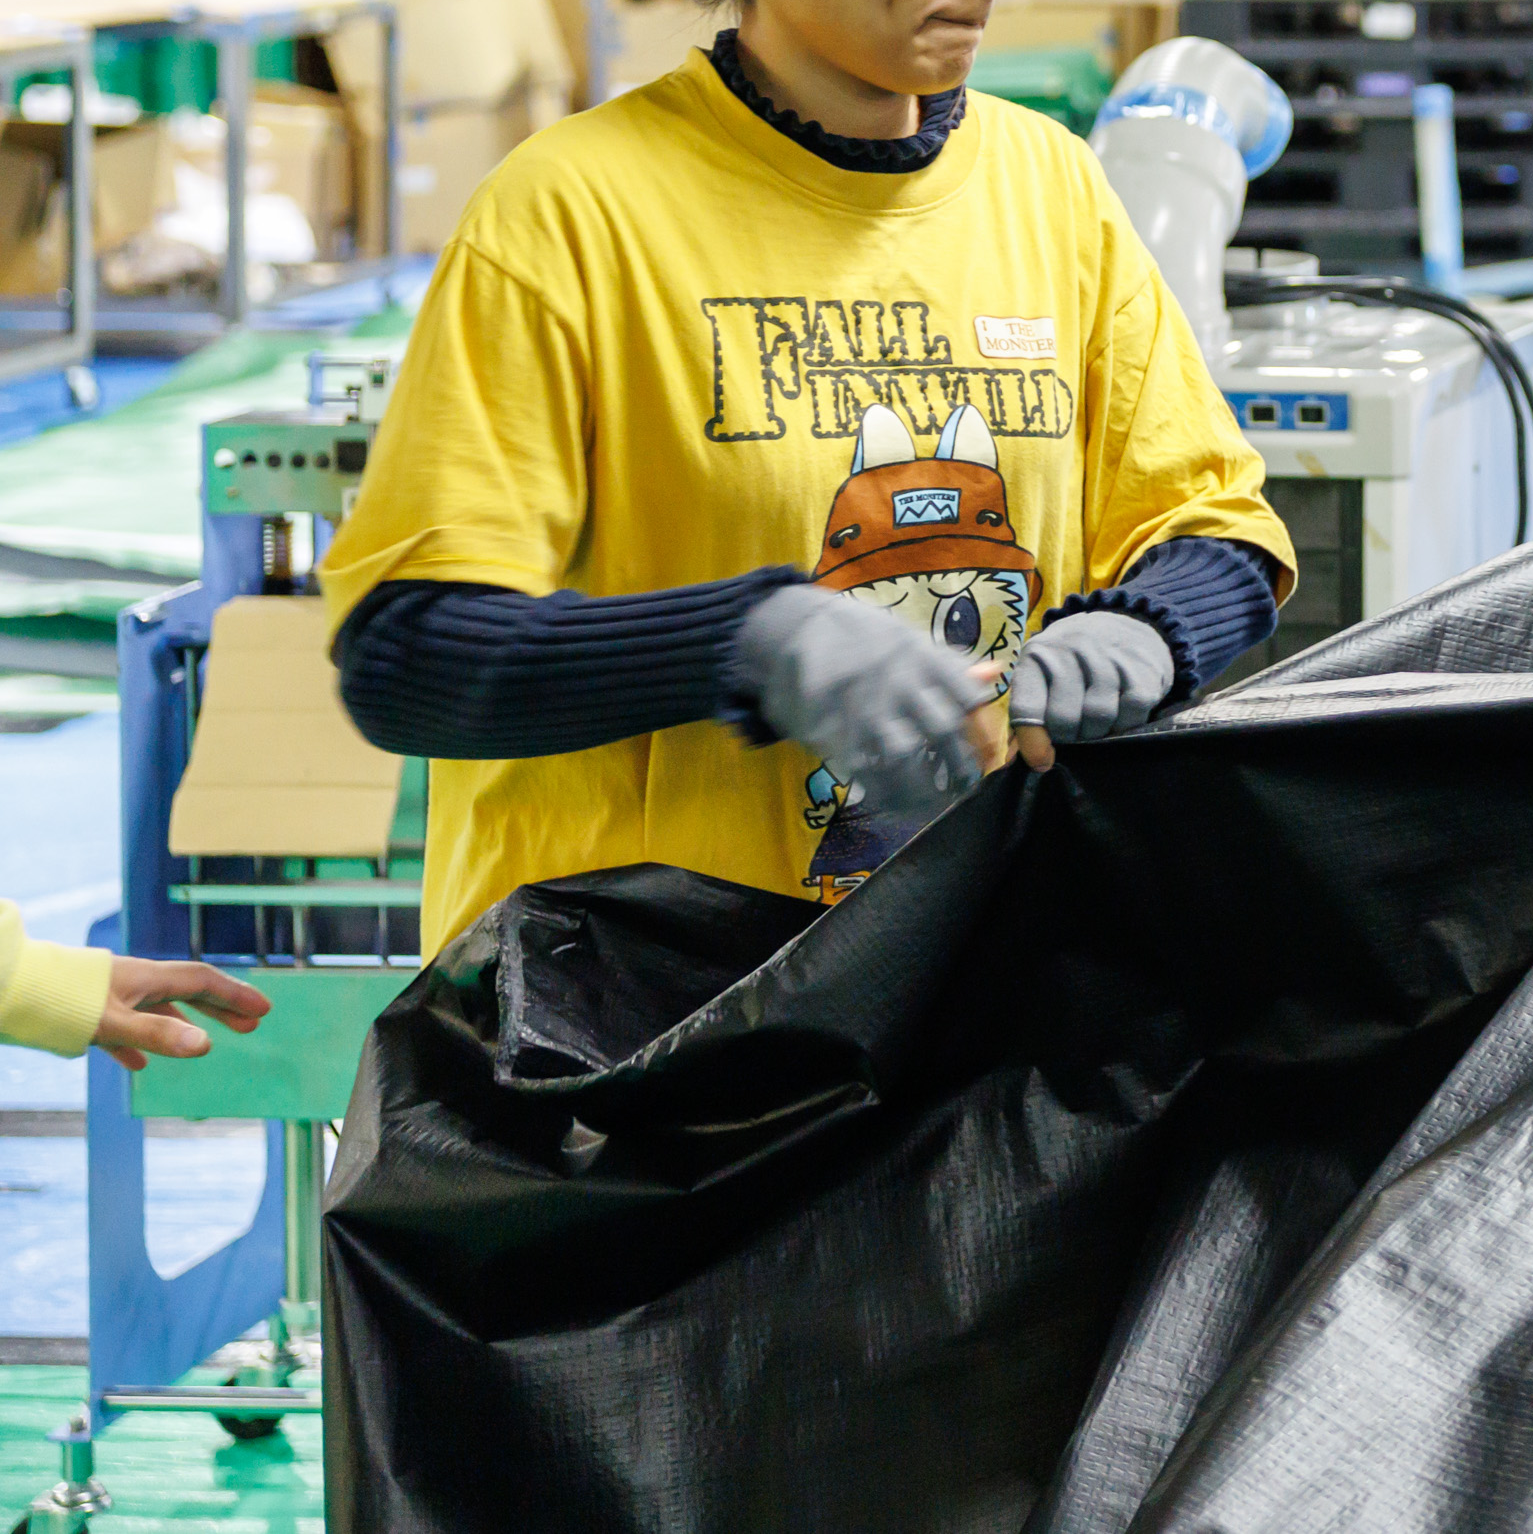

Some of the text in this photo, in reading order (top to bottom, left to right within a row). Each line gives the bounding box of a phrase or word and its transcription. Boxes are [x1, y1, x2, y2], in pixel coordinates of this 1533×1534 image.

[1005, 323, 1035, 337] THE
[701, 297, 953, 442] FALL
[899, 493, 956, 505] THE MONSTERS
